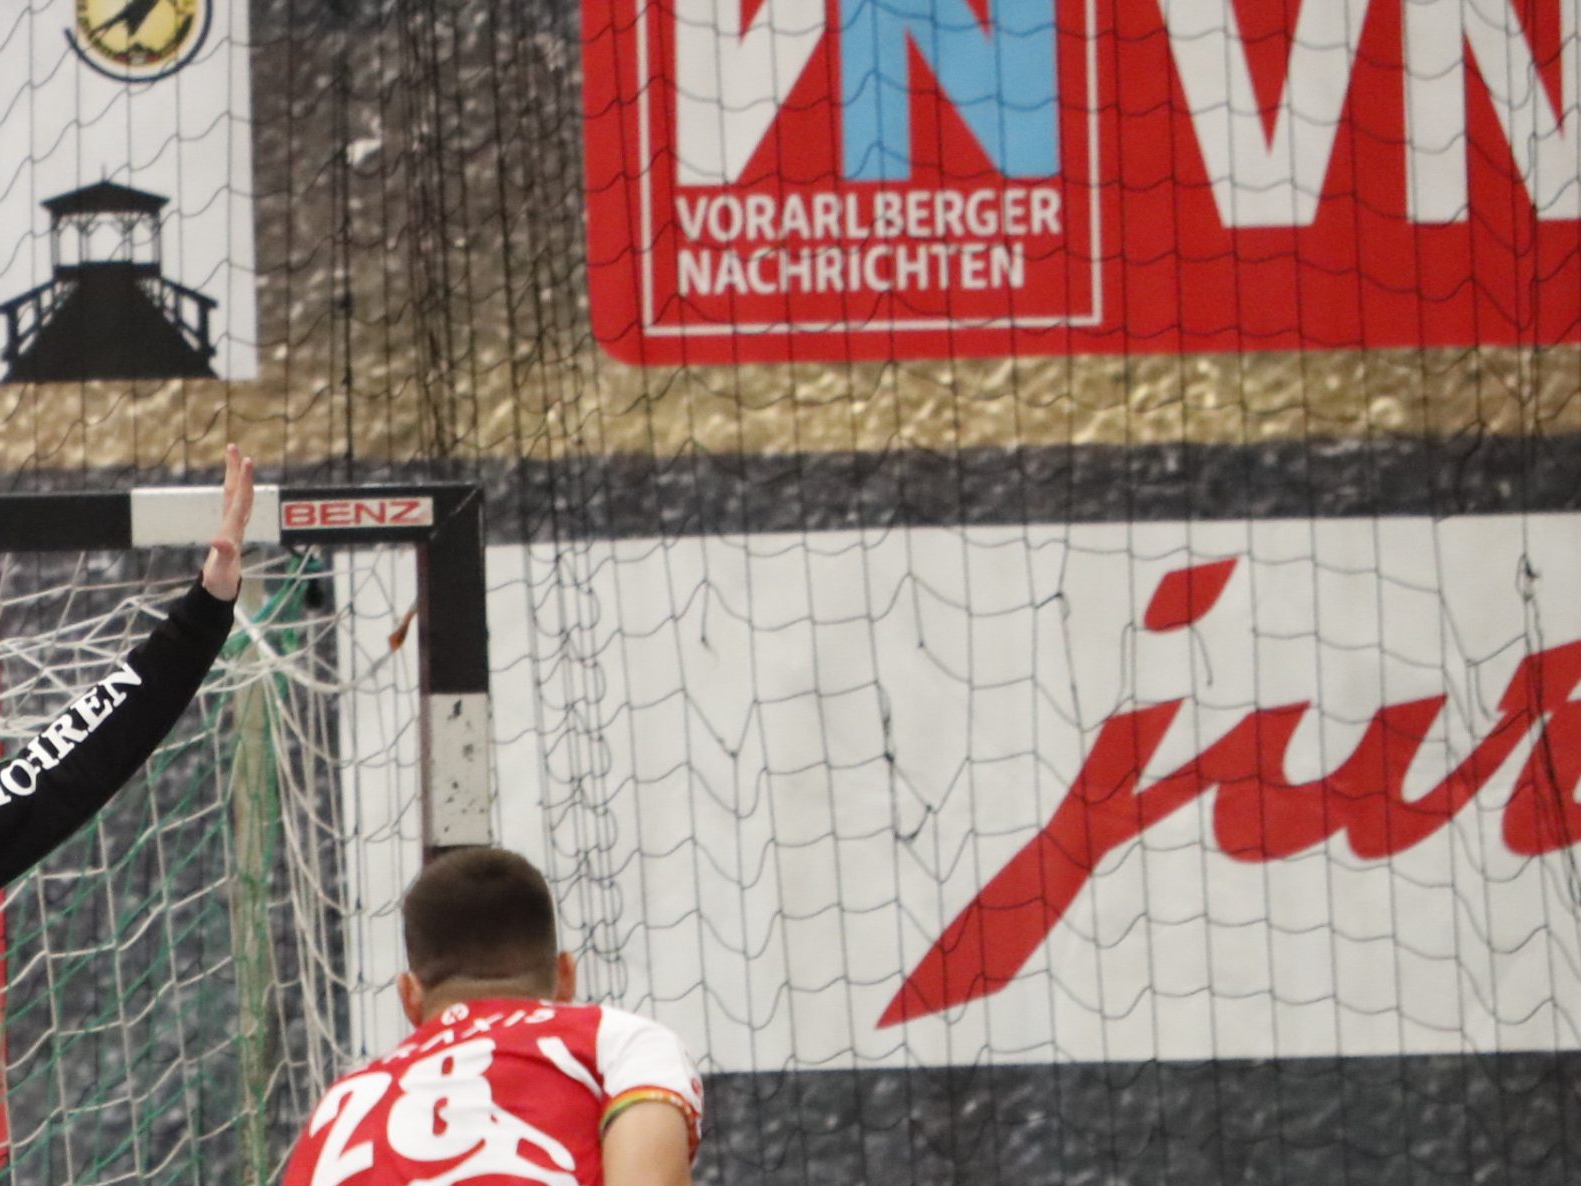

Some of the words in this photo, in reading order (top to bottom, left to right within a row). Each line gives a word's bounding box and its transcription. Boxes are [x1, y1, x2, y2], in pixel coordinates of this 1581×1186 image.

[674, 187, 1062, 242] VORARLBERGER
[677, 243, 1025, 297] NACHRICHTEN
[284, 500, 421, 527] BENZ
